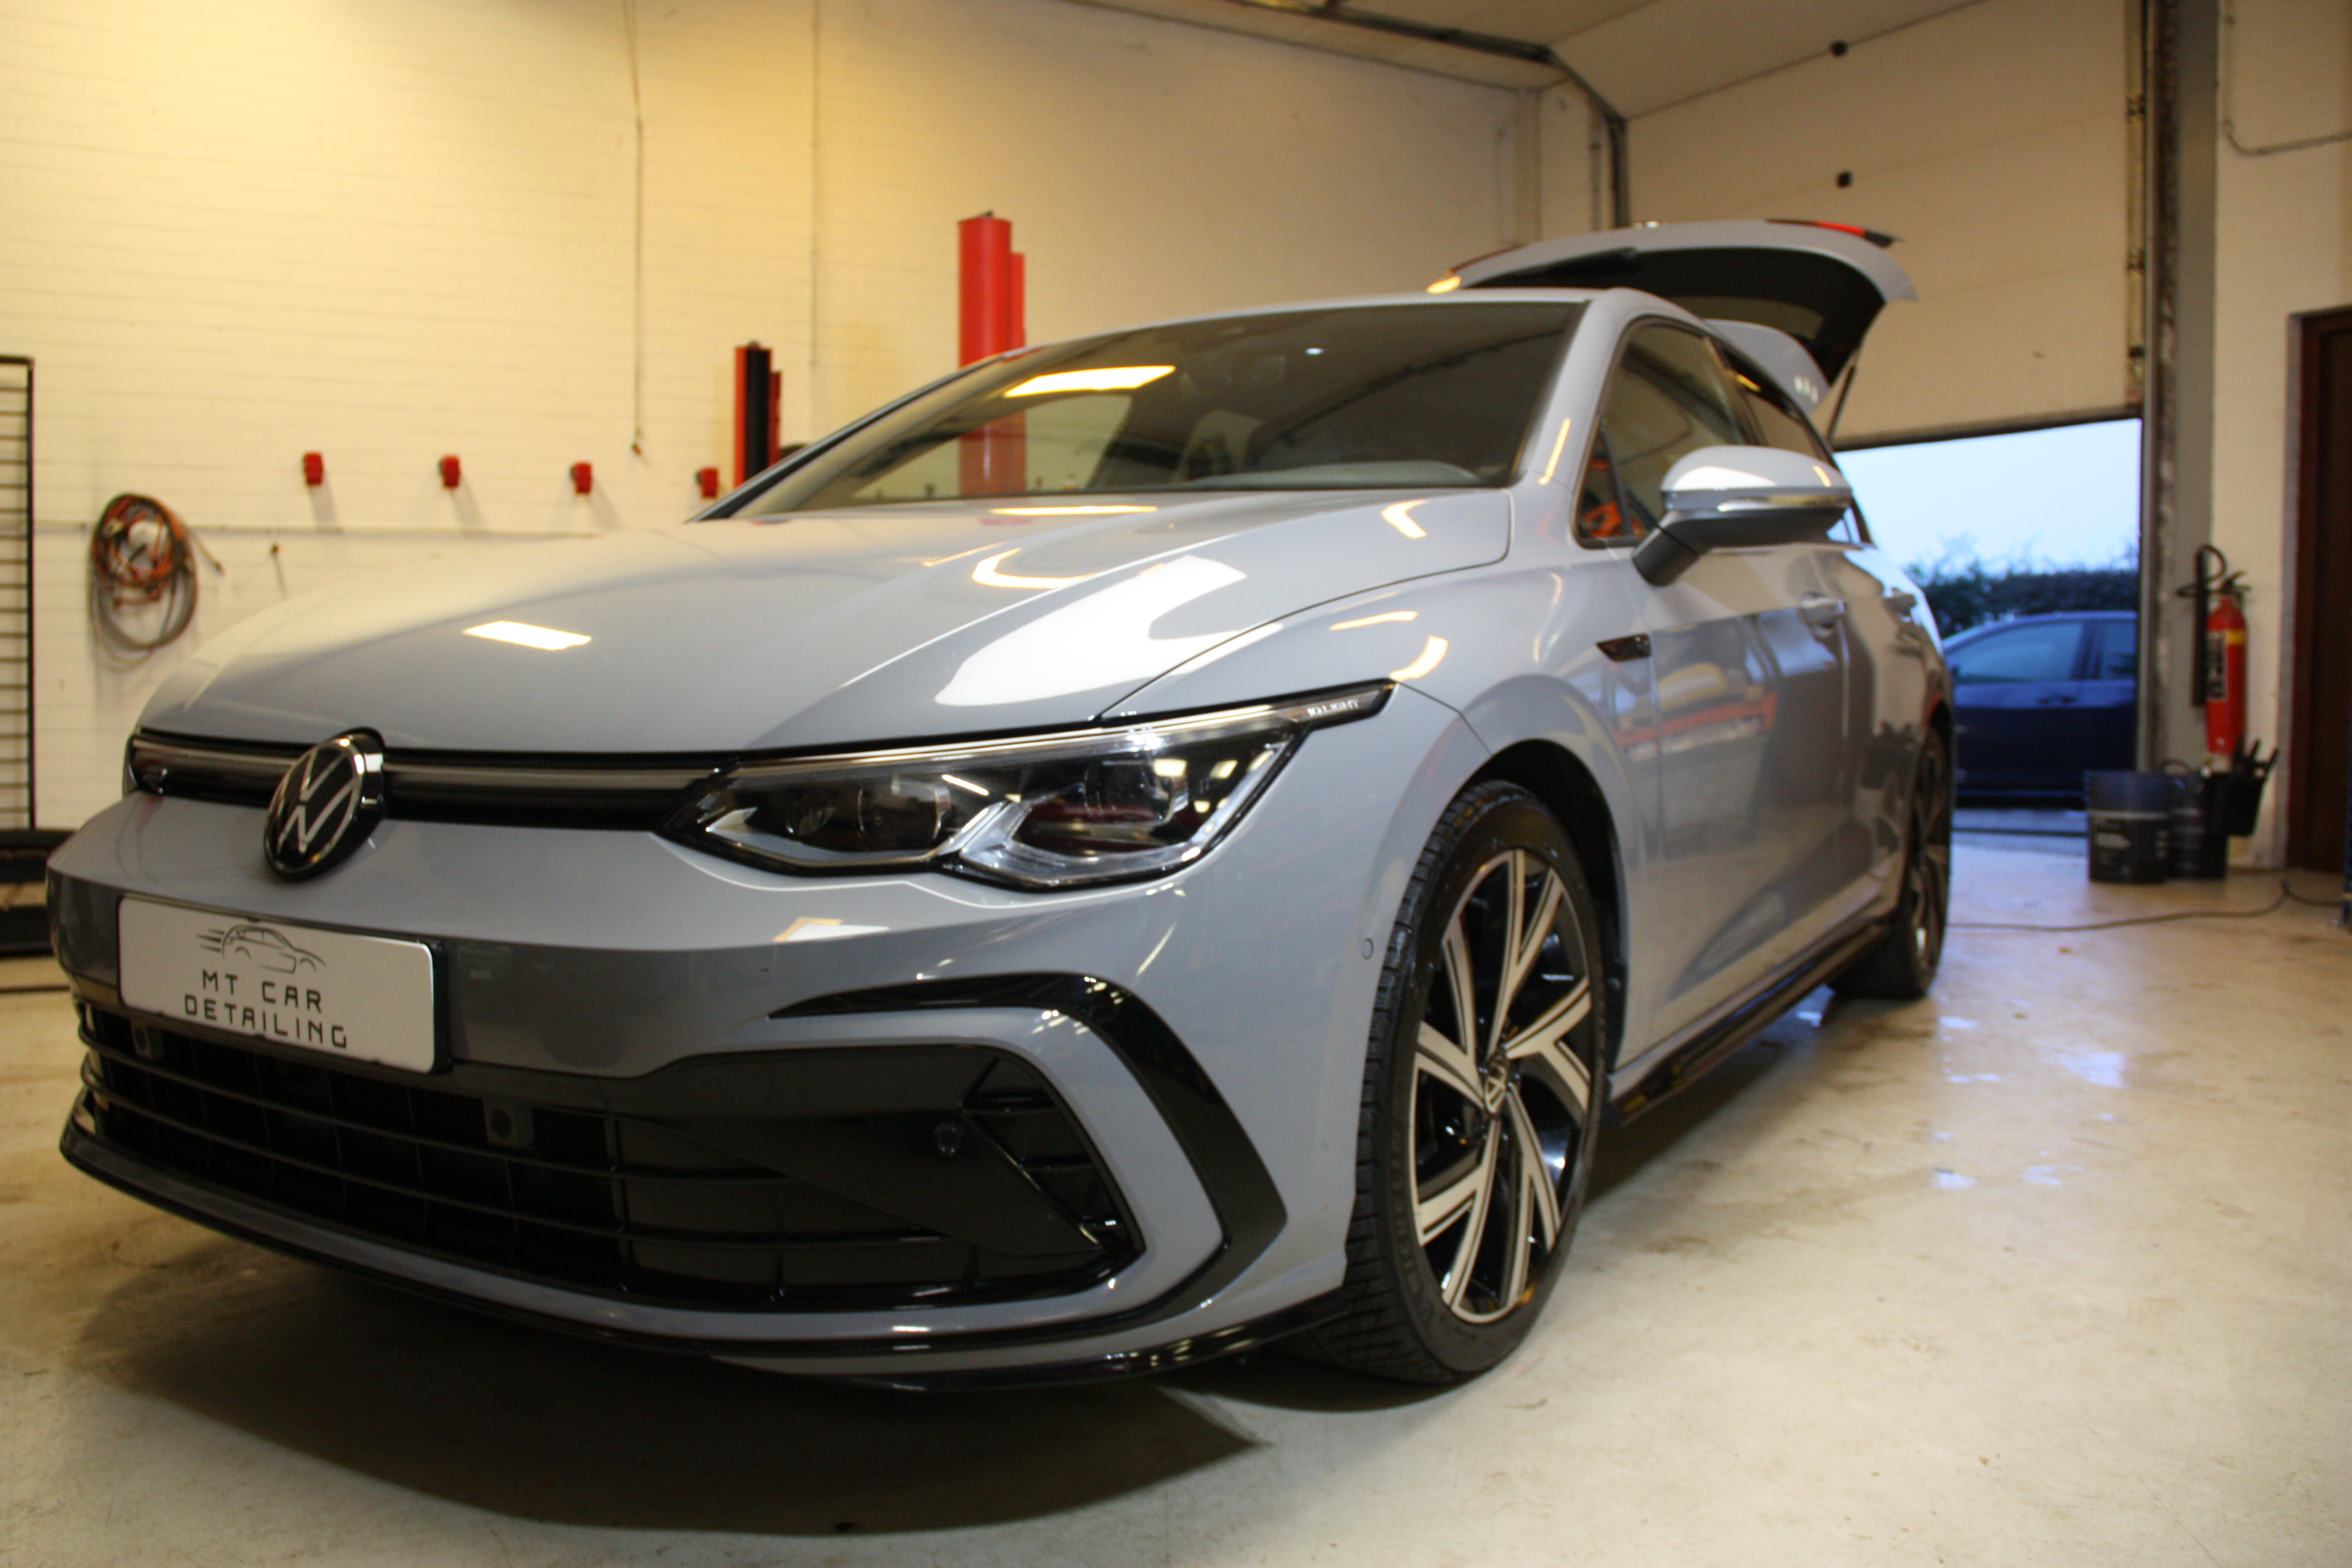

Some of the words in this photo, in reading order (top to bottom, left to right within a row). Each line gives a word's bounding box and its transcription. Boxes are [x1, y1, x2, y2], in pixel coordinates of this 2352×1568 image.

[202, 968, 238, 995] MT
[262, 981, 323, 1013] CAR
[184, 994, 348, 1049] DETAILING
